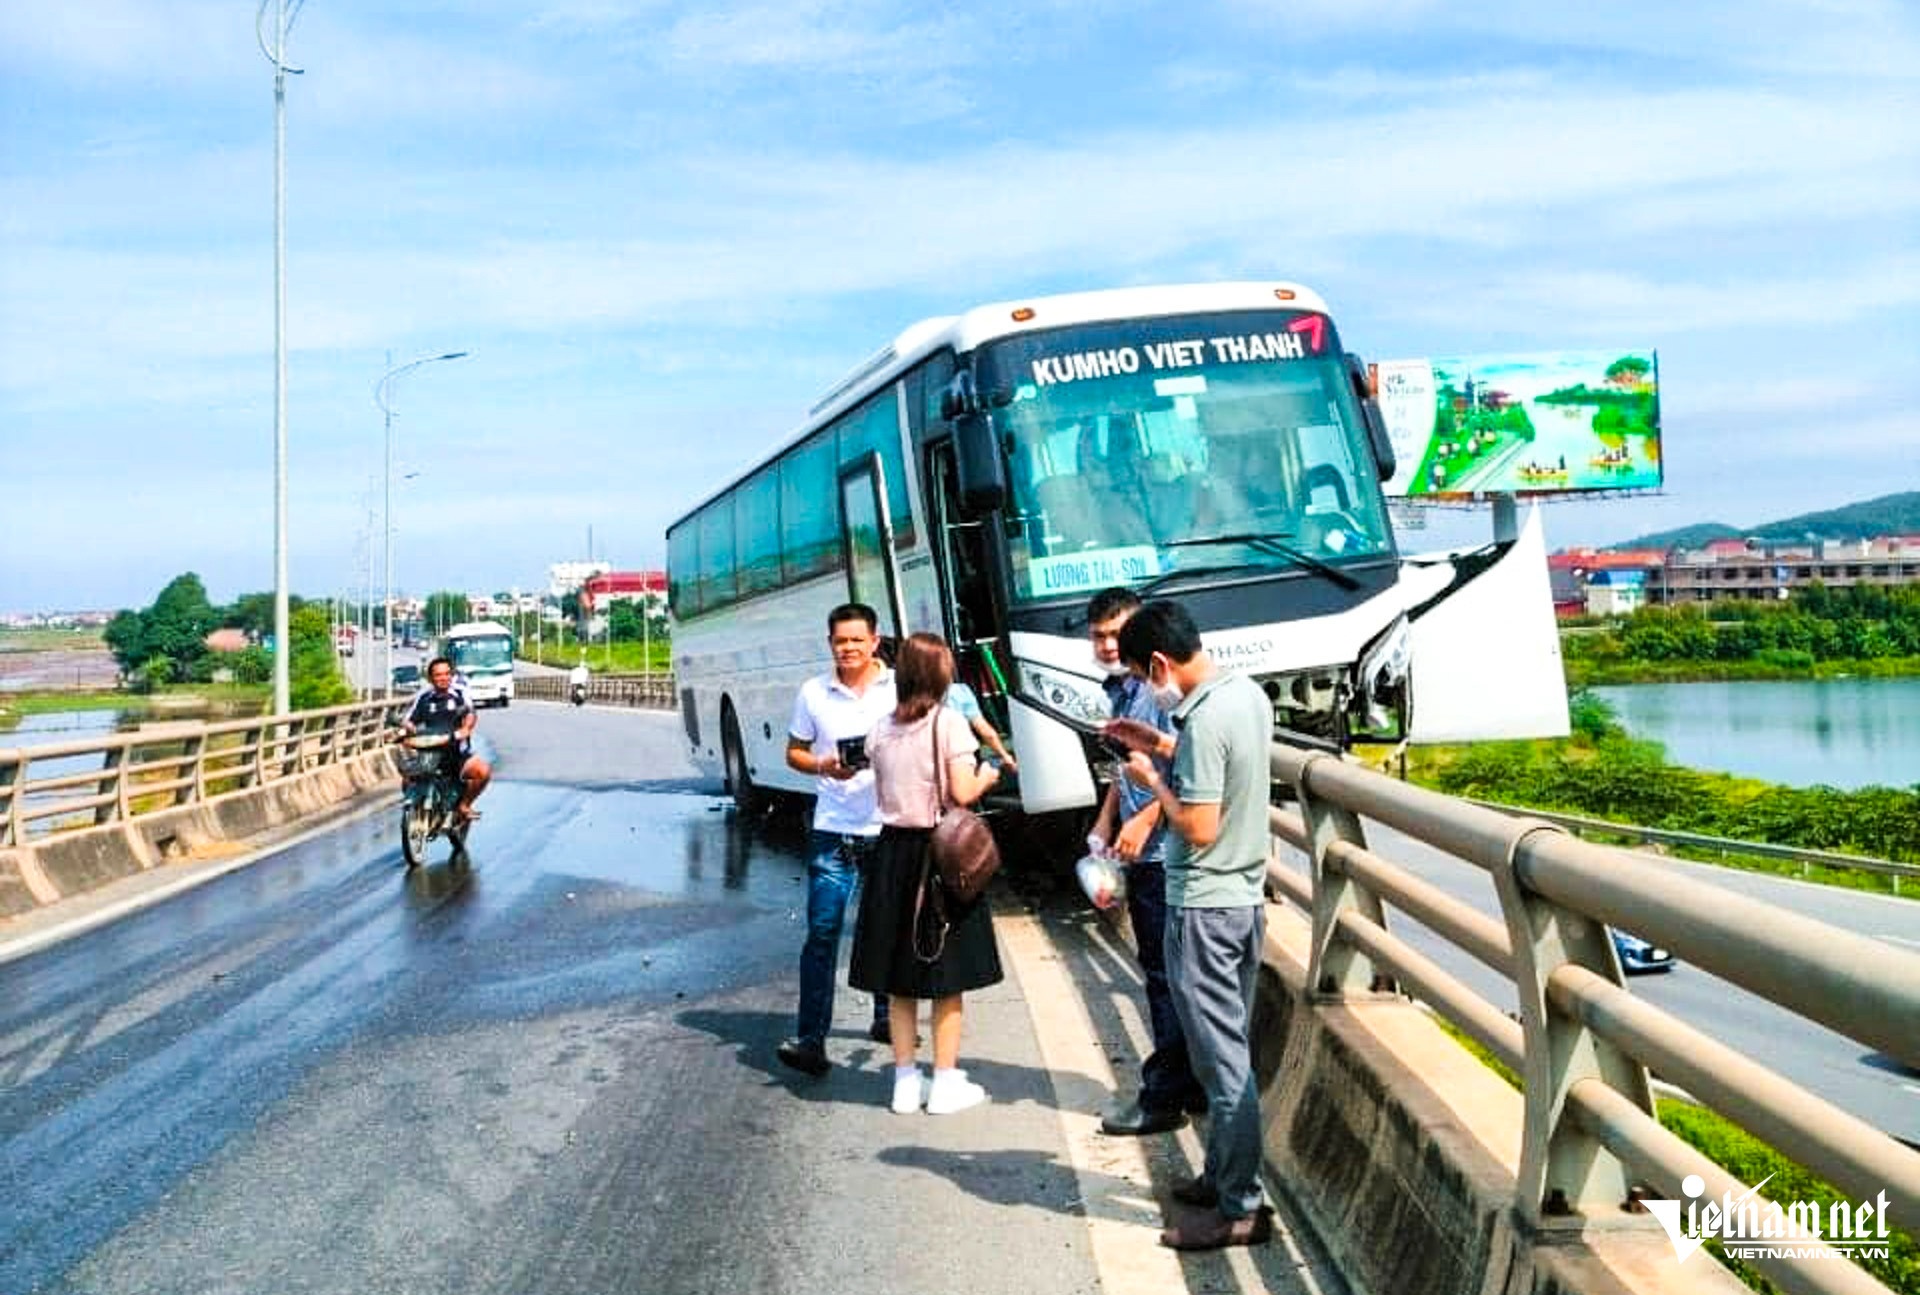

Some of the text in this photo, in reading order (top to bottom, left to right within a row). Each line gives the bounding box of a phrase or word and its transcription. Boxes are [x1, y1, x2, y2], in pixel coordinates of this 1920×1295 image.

[1032, 332, 1304, 386] KUMHO VIET THANH
[1206, 639, 1273, 662] THACO
